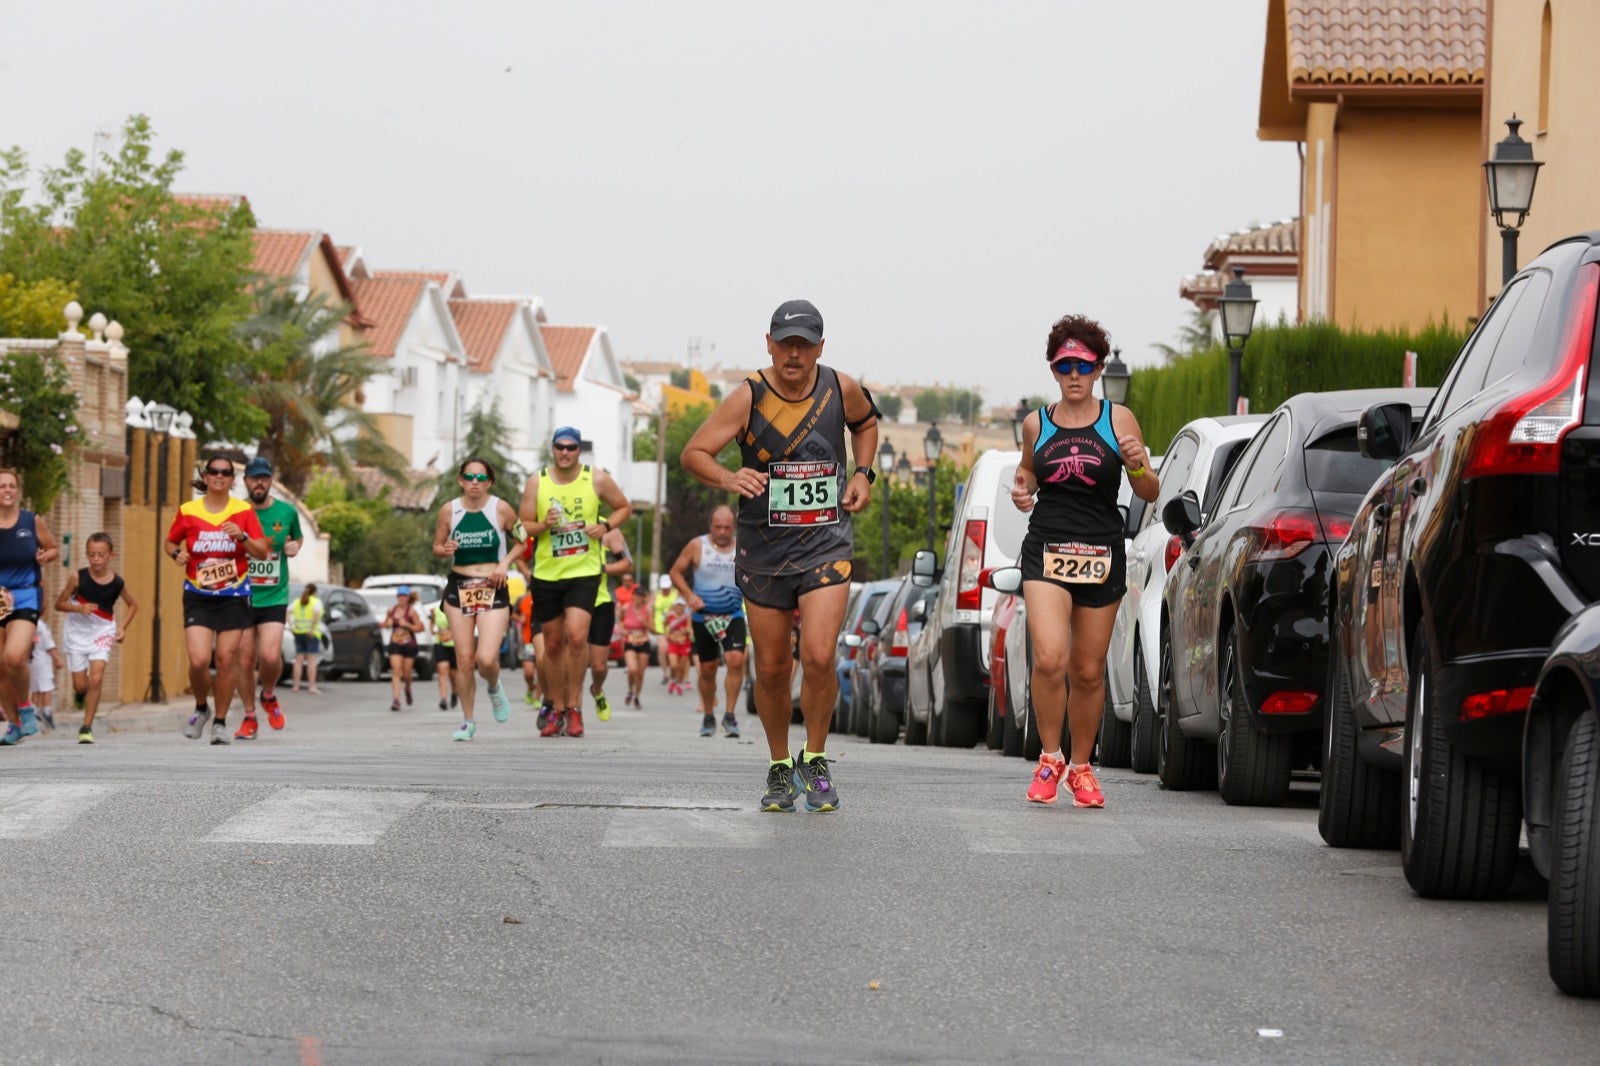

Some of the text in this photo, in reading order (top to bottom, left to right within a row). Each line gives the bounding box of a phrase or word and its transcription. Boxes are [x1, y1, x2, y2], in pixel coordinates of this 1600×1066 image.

[783, 481, 829, 506] 135
[557, 531, 583, 547] 703
[202, 564, 234, 582] 2180
[248, 562, 274, 575] 900
[1052, 557, 1106, 579] 2249
